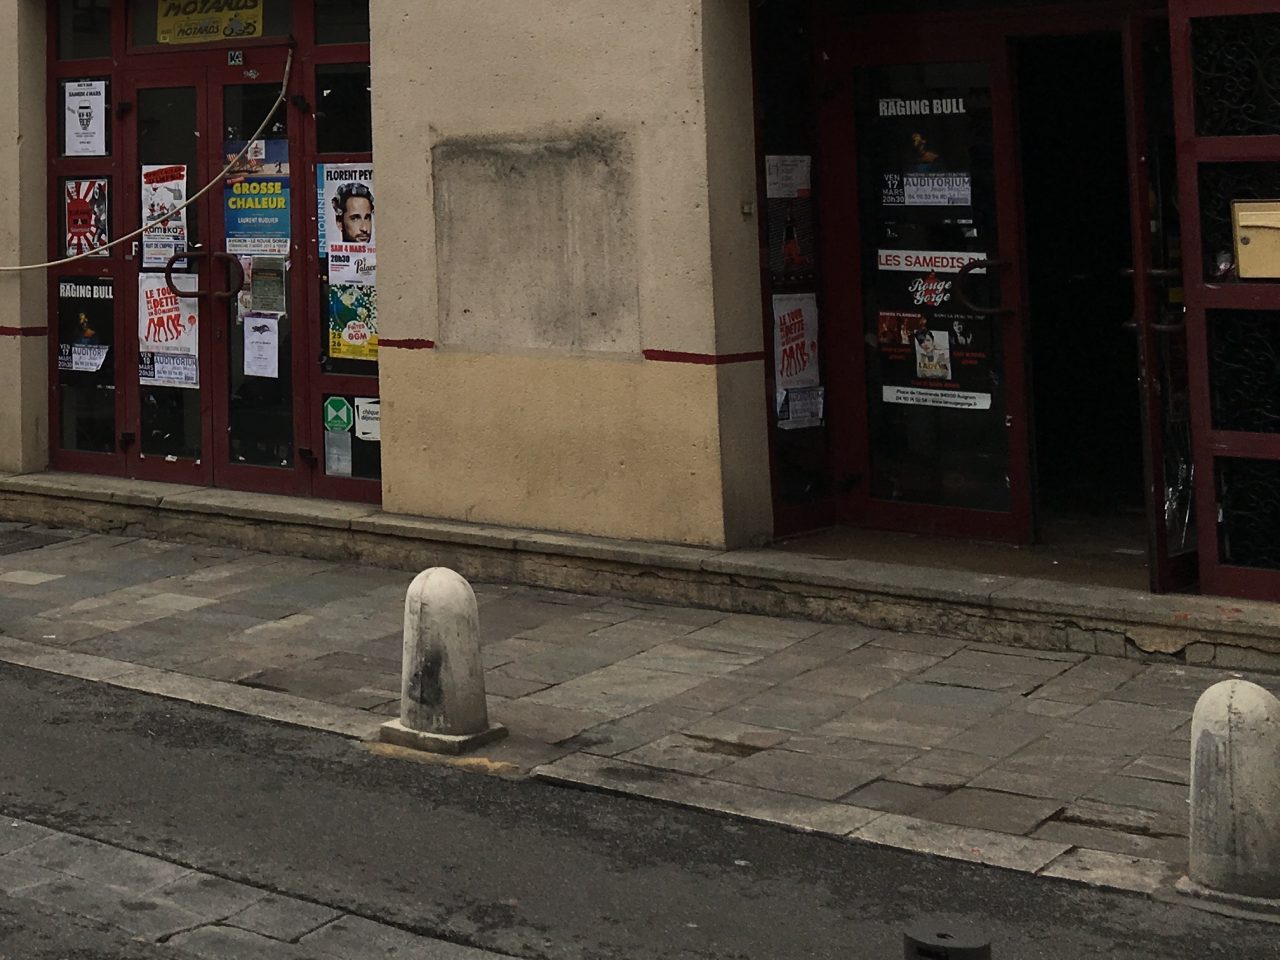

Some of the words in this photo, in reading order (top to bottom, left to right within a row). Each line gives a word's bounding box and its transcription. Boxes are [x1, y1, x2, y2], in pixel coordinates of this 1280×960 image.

[177, 25, 219, 37] MOTARDS
[879, 100, 930, 116] RAGING
[932, 98, 967, 114] BULL
[326, 170, 359, 181] FLORENT
[233, 182, 282, 195] GROSSE
[888, 181, 899, 189] 17
[905, 178, 971, 187] AUDITORIUM
[882, 188, 904, 196] MARS
[228, 197, 286, 209] CHALEUR
[882, 195, 905, 203] 20h30
[331, 244, 343, 252] SAM
[344, 244, 348, 252] 4
[349, 245, 366, 253] MARS
[330, 254, 350, 263] 20h30
[879, 255, 900, 266] LES
[905, 255, 964, 269] SAMEDIS
[354, 258, 377, 274] Palace
[60, 284, 92, 298] RAGING
[93, 285, 114, 299] BULL
[908, 278, 952, 294] Rouge
[145, 289, 154, 299] LE
[157, 287, 172, 297] TOU
[153, 296, 179, 309] DETTE
[913, 292, 951, 307] Gorge
